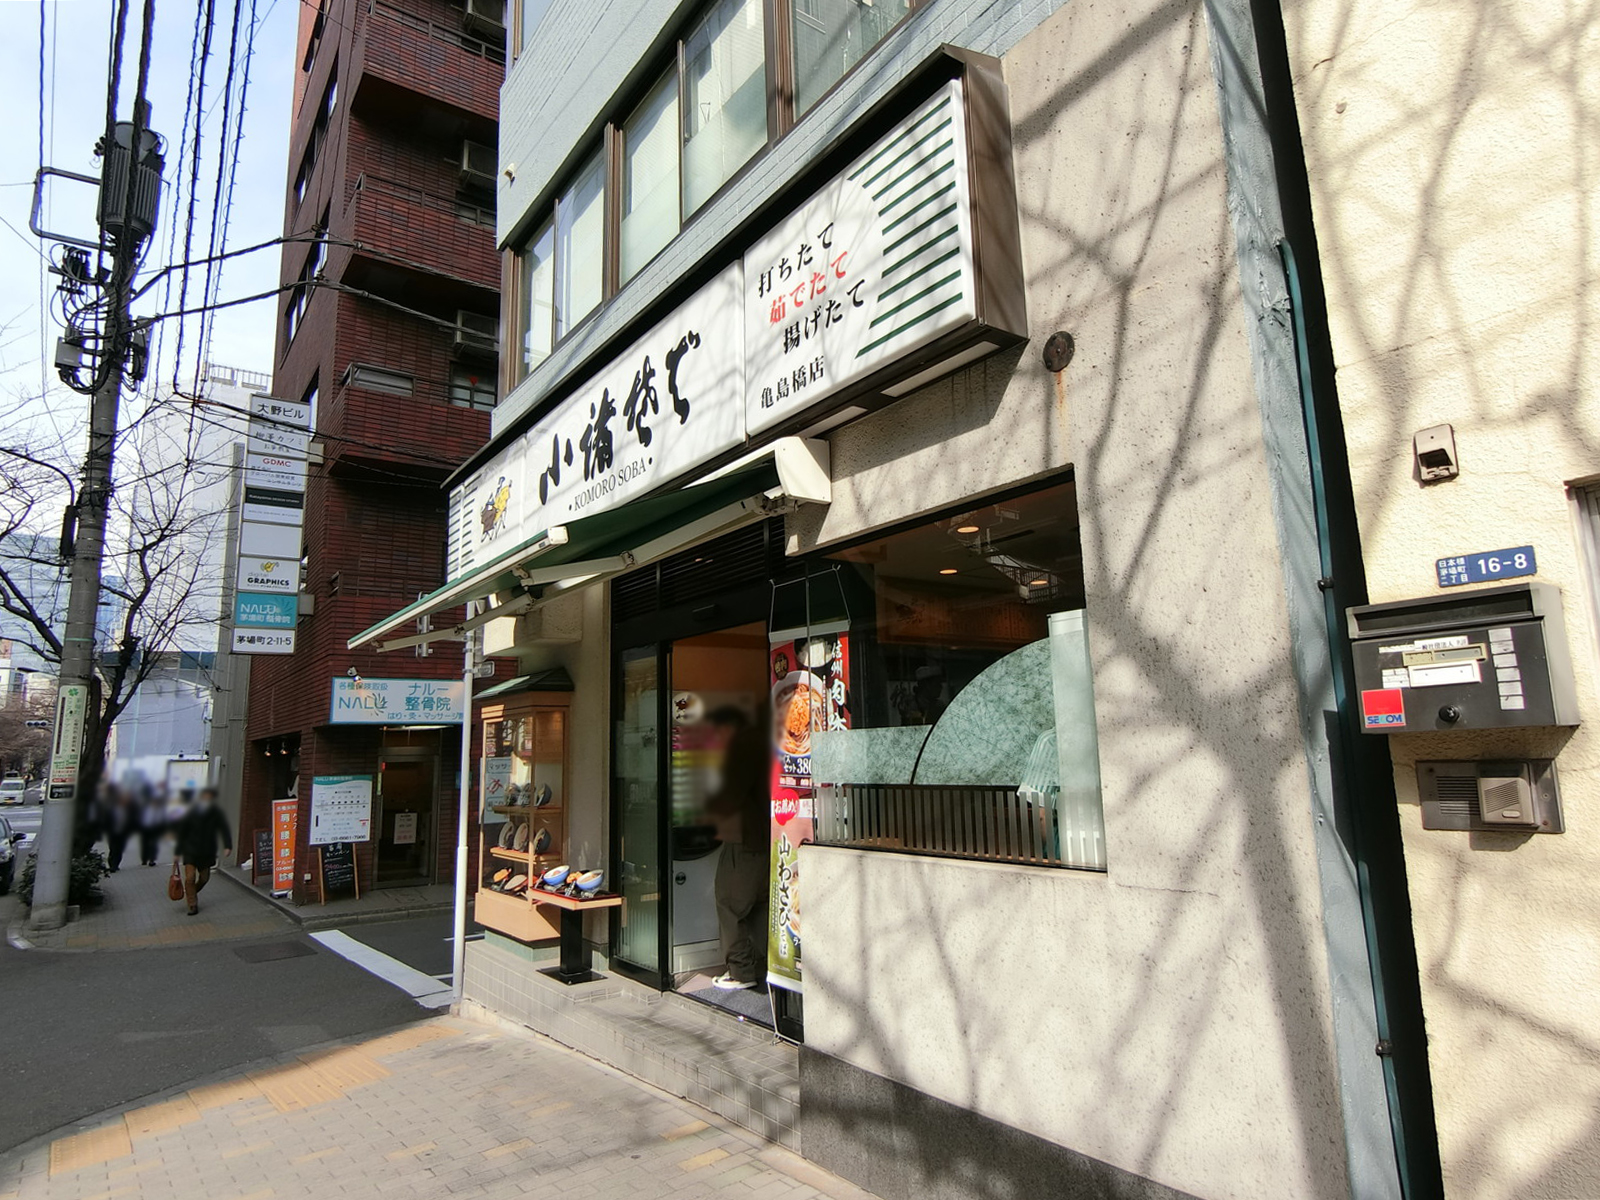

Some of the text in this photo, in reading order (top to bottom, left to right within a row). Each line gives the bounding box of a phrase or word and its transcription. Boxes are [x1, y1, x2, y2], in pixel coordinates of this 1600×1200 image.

[758, 222, 834, 298] 打ちたて
[769, 251, 848, 328] 茹でたて
[783, 279, 865, 355] 揚げたて
[761, 355, 824, 409] 亀島橋店
[257, 403, 304, 419] 大野ビル
[262, 457, 292, 467] GDMC
[574, 457, 647, 511] KOMORO SOBA
[1438, 557, 1466, 568] 日本橋
[1477, 553, 1528, 574] 16-8
[247, 577, 290, 586] GRAPHICS
[1440, 573, 1468, 585] 二丁目
[237, 635, 292, 646] 茅場町2-11-5
[408, 683, 449, 696] ナルー
[405, 697, 451, 711] 整骨院
[1367, 714, 1403, 725] SECOM
